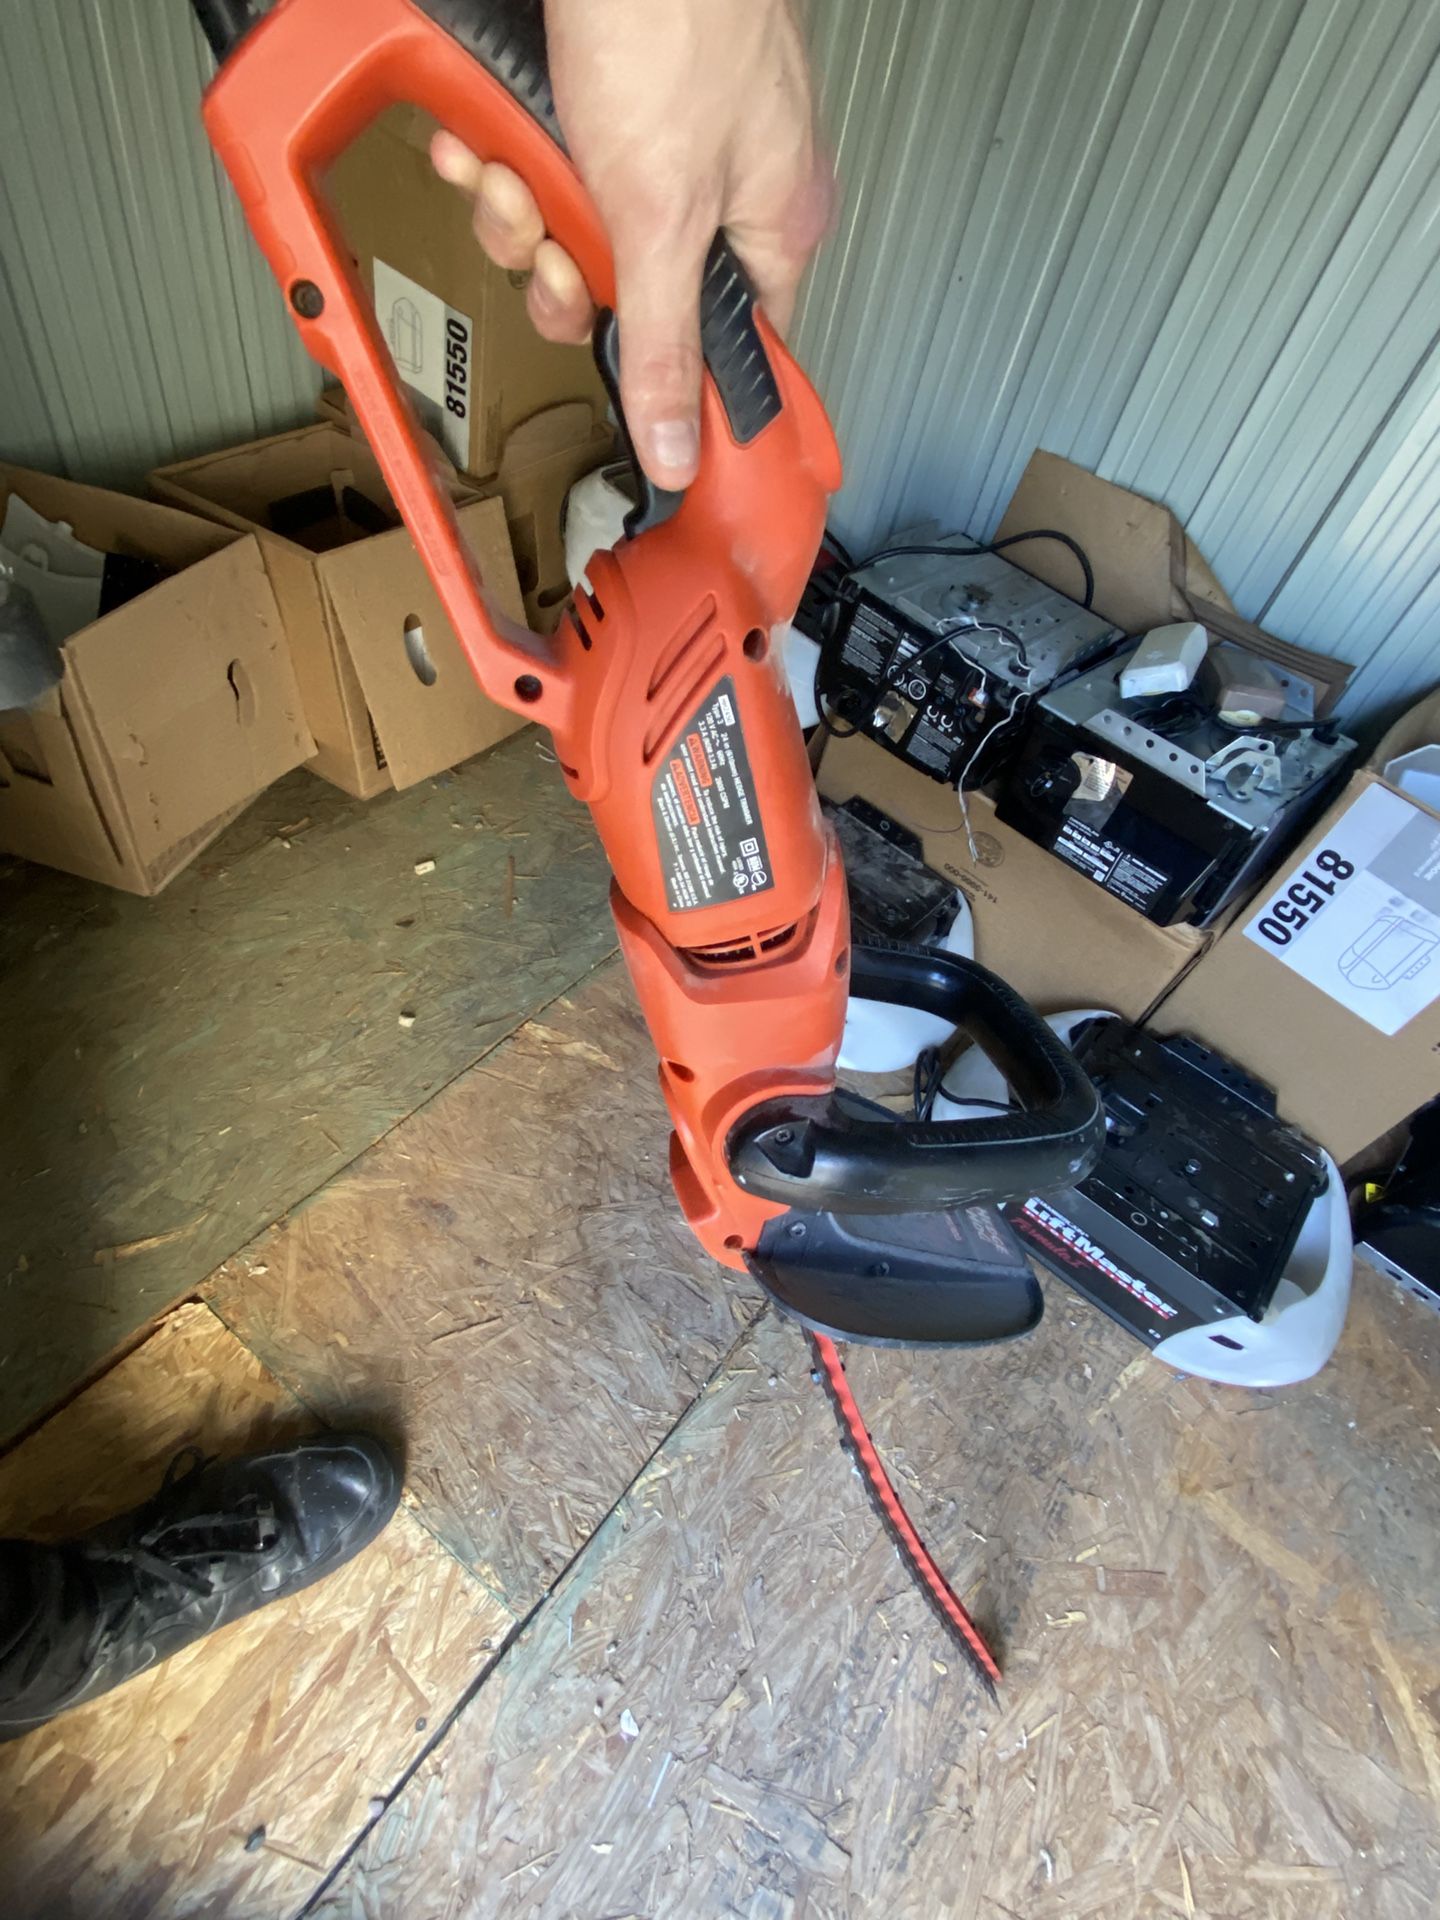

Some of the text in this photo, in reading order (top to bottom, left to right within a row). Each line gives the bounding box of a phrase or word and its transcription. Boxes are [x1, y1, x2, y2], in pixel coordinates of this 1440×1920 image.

[446, 318, 468, 419] 81550
[704, 711, 714, 724] 120
[710, 702, 722, 719] Type
[720, 731, 729, 742] 24
[691, 745, 709, 784] WARNING
[689, 771, 698, 786] read
[733, 776, 745, 797] HEDGE
[674, 769, 698, 822] ADVERTENCIA
[693, 785, 701, 797] and
[696, 797, 711, 827] understand
[705, 796, 715, 814] reduce
[738, 797, 753, 825] TRIMMER
[710, 815, 718, 824] the
[713, 824, 721, 834] risk
[690, 826, 700, 839] Para
[706, 827, 720, 854] instruction
[694, 838, 705, 857] reducir
[1258, 849, 1355, 946] 81550
[1024, 1197, 1178, 1317] LiftMaster
